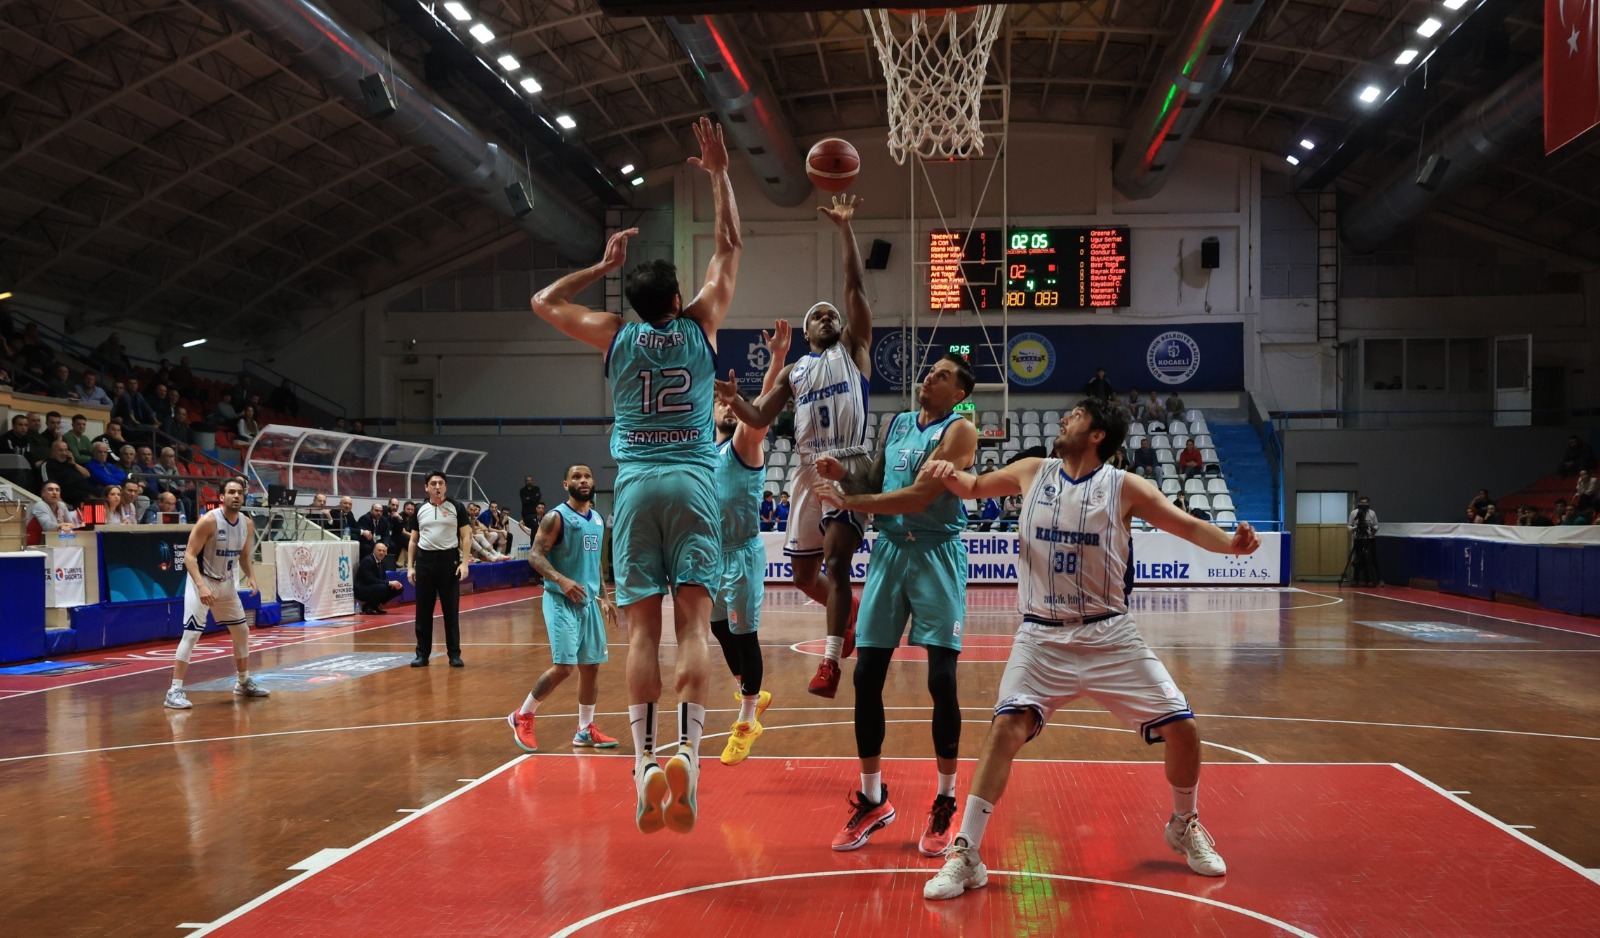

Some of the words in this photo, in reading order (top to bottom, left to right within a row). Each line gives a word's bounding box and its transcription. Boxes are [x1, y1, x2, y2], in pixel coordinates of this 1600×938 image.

[1012, 234, 1028, 249] 02
[1032, 234, 1048, 248] 05
[1010, 265, 1026, 278] 02
[1027, 281, 1034, 290] 4
[1035, 292, 1058, 306] 083
[636, 330, 684, 350] BİRR
[960, 345, 970, 354] 05
[638, 368, 694, 414] 12
[818, 405, 830, 428] 3
[894, 449, 926, 472] 37
[583, 534, 598, 551] 63
[1036, 526, 1100, 546] KAĞITSPOR
[968, 564, 1018, 578] IMINA
[1136, 561, 1189, 578] İLERİZ
[1054, 551, 1077, 575] 38
[1208, 568, 1246, 578] BELDE
[1249, 568, 1270, 579] A.Ş.
